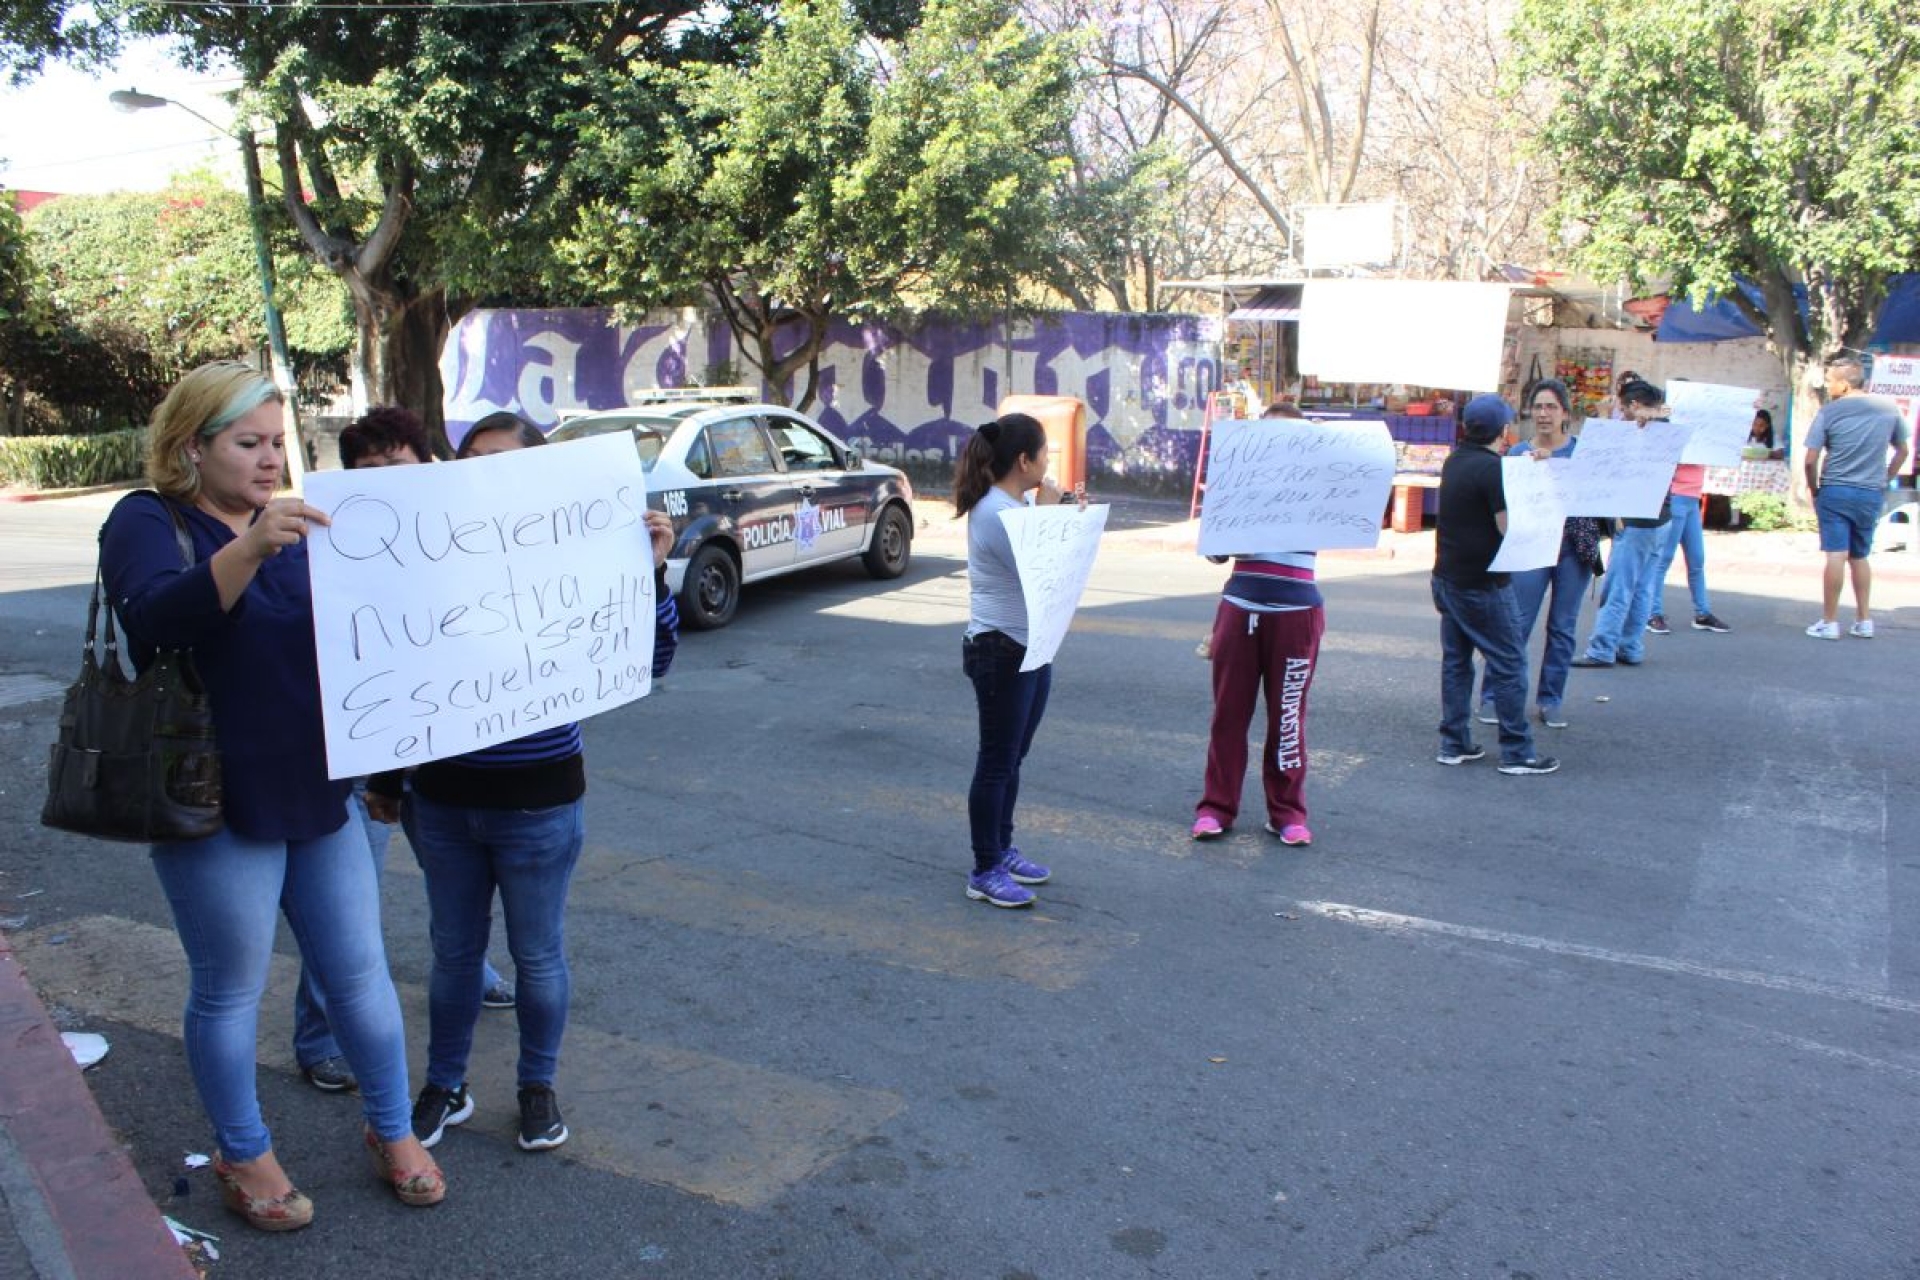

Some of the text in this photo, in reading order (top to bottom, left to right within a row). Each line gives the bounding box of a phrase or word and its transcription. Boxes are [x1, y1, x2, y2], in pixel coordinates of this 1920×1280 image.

[328, 485, 639, 568] Queremos
[663, 490, 689, 517] 1605
[742, 507, 846, 551] POLICÍA VIAL
[342, 626, 630, 741] Escuela en
[1277, 658, 1311, 771] AEROPOSTALE
[394, 726, 433, 760] el
[474, 687, 584, 741] mismo
